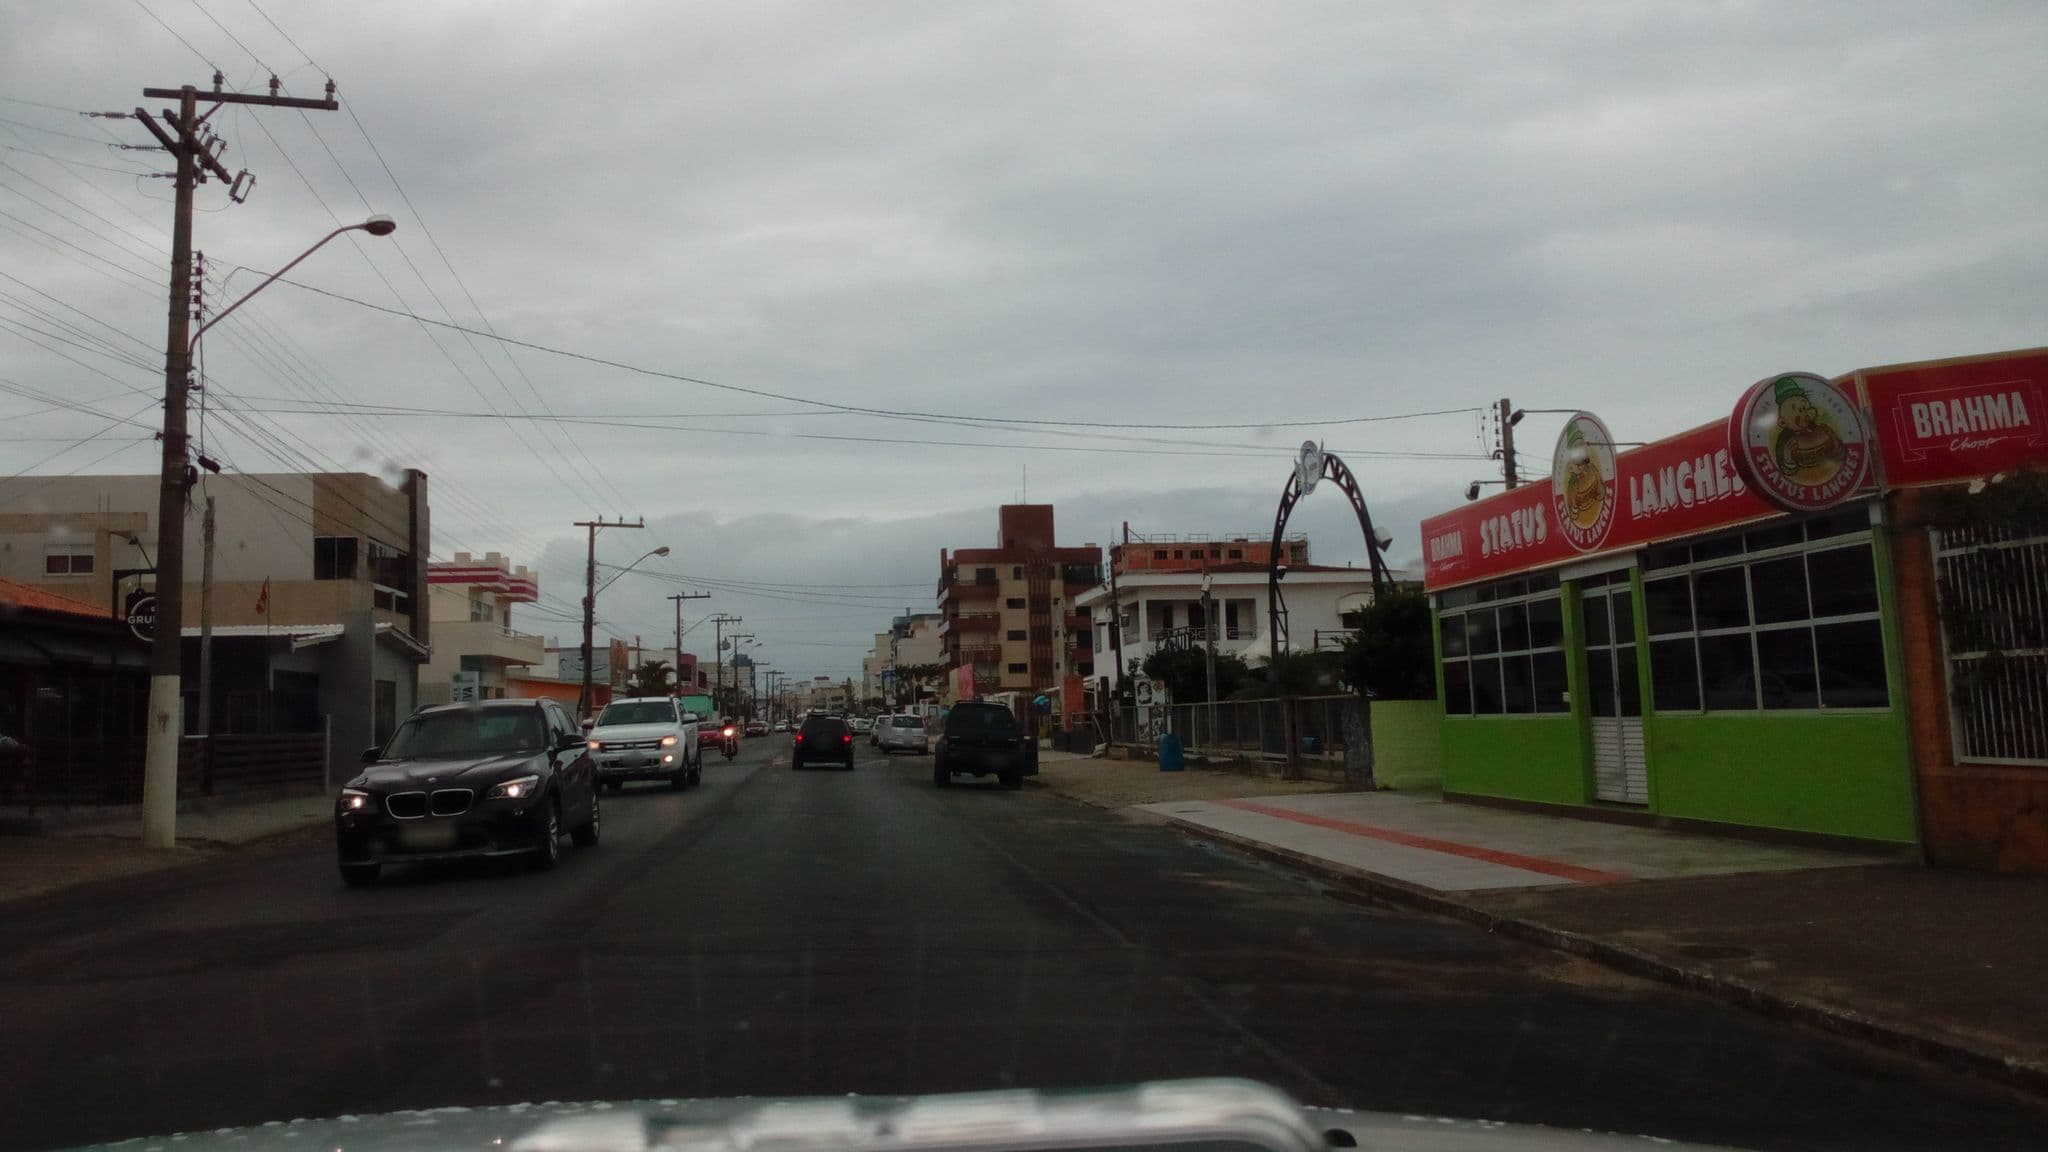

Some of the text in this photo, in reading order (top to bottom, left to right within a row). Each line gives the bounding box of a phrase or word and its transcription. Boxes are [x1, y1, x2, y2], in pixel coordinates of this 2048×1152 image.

[1910, 391, 2030, 439] BRAHMA
[1948, 436, 2000, 452] Chopp
[1756, 448, 1860, 501] STATUS LANCHES
[1479, 502, 1547, 559] STATUS
[1557, 487, 1614, 545] STATUS LANCHES
[1430, 530, 1463, 563] BRAHMA
[127, 615, 155, 624] GRU
